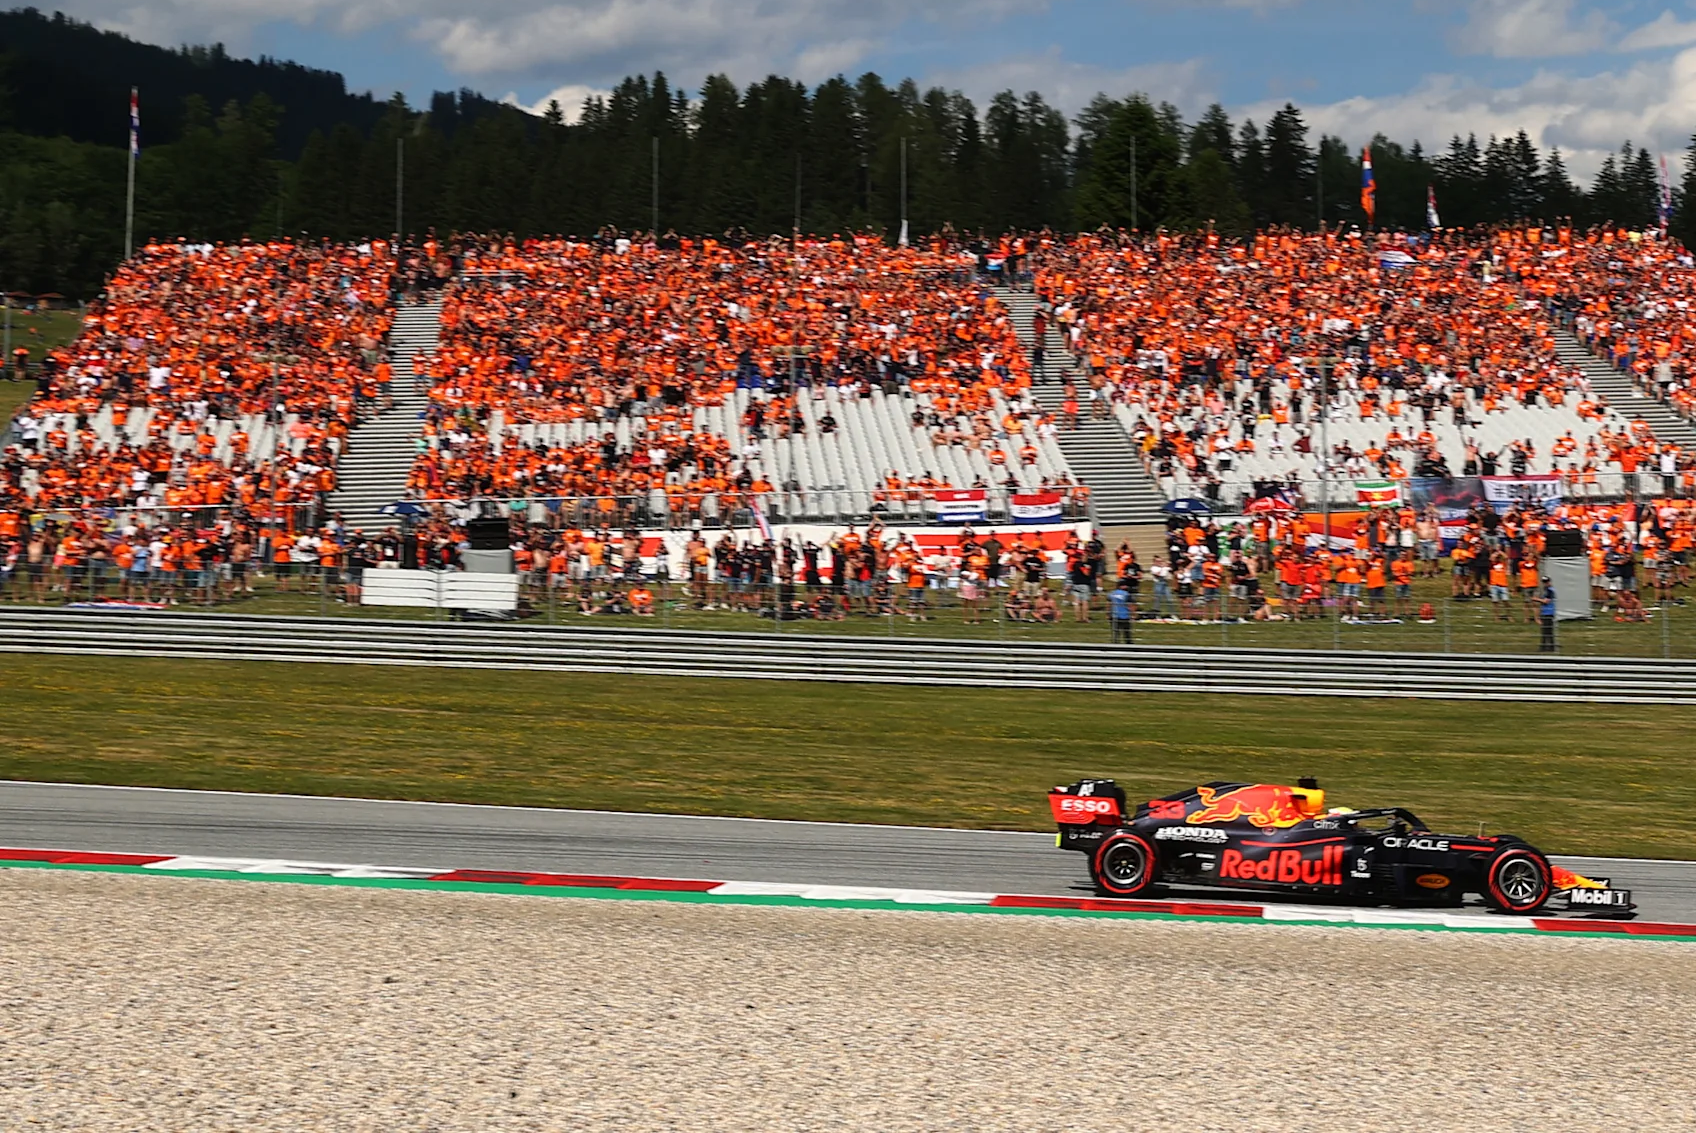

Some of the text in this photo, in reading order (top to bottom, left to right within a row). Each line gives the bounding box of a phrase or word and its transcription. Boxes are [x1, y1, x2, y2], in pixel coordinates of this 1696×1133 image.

[1060, 798, 1111, 813] ESSO
[1148, 800, 1186, 820] 33
[1156, 826, 1229, 839] HONDA
[1383, 837, 1449, 851] ORACLE
[1571, 888, 1625, 905] Mobil 1
